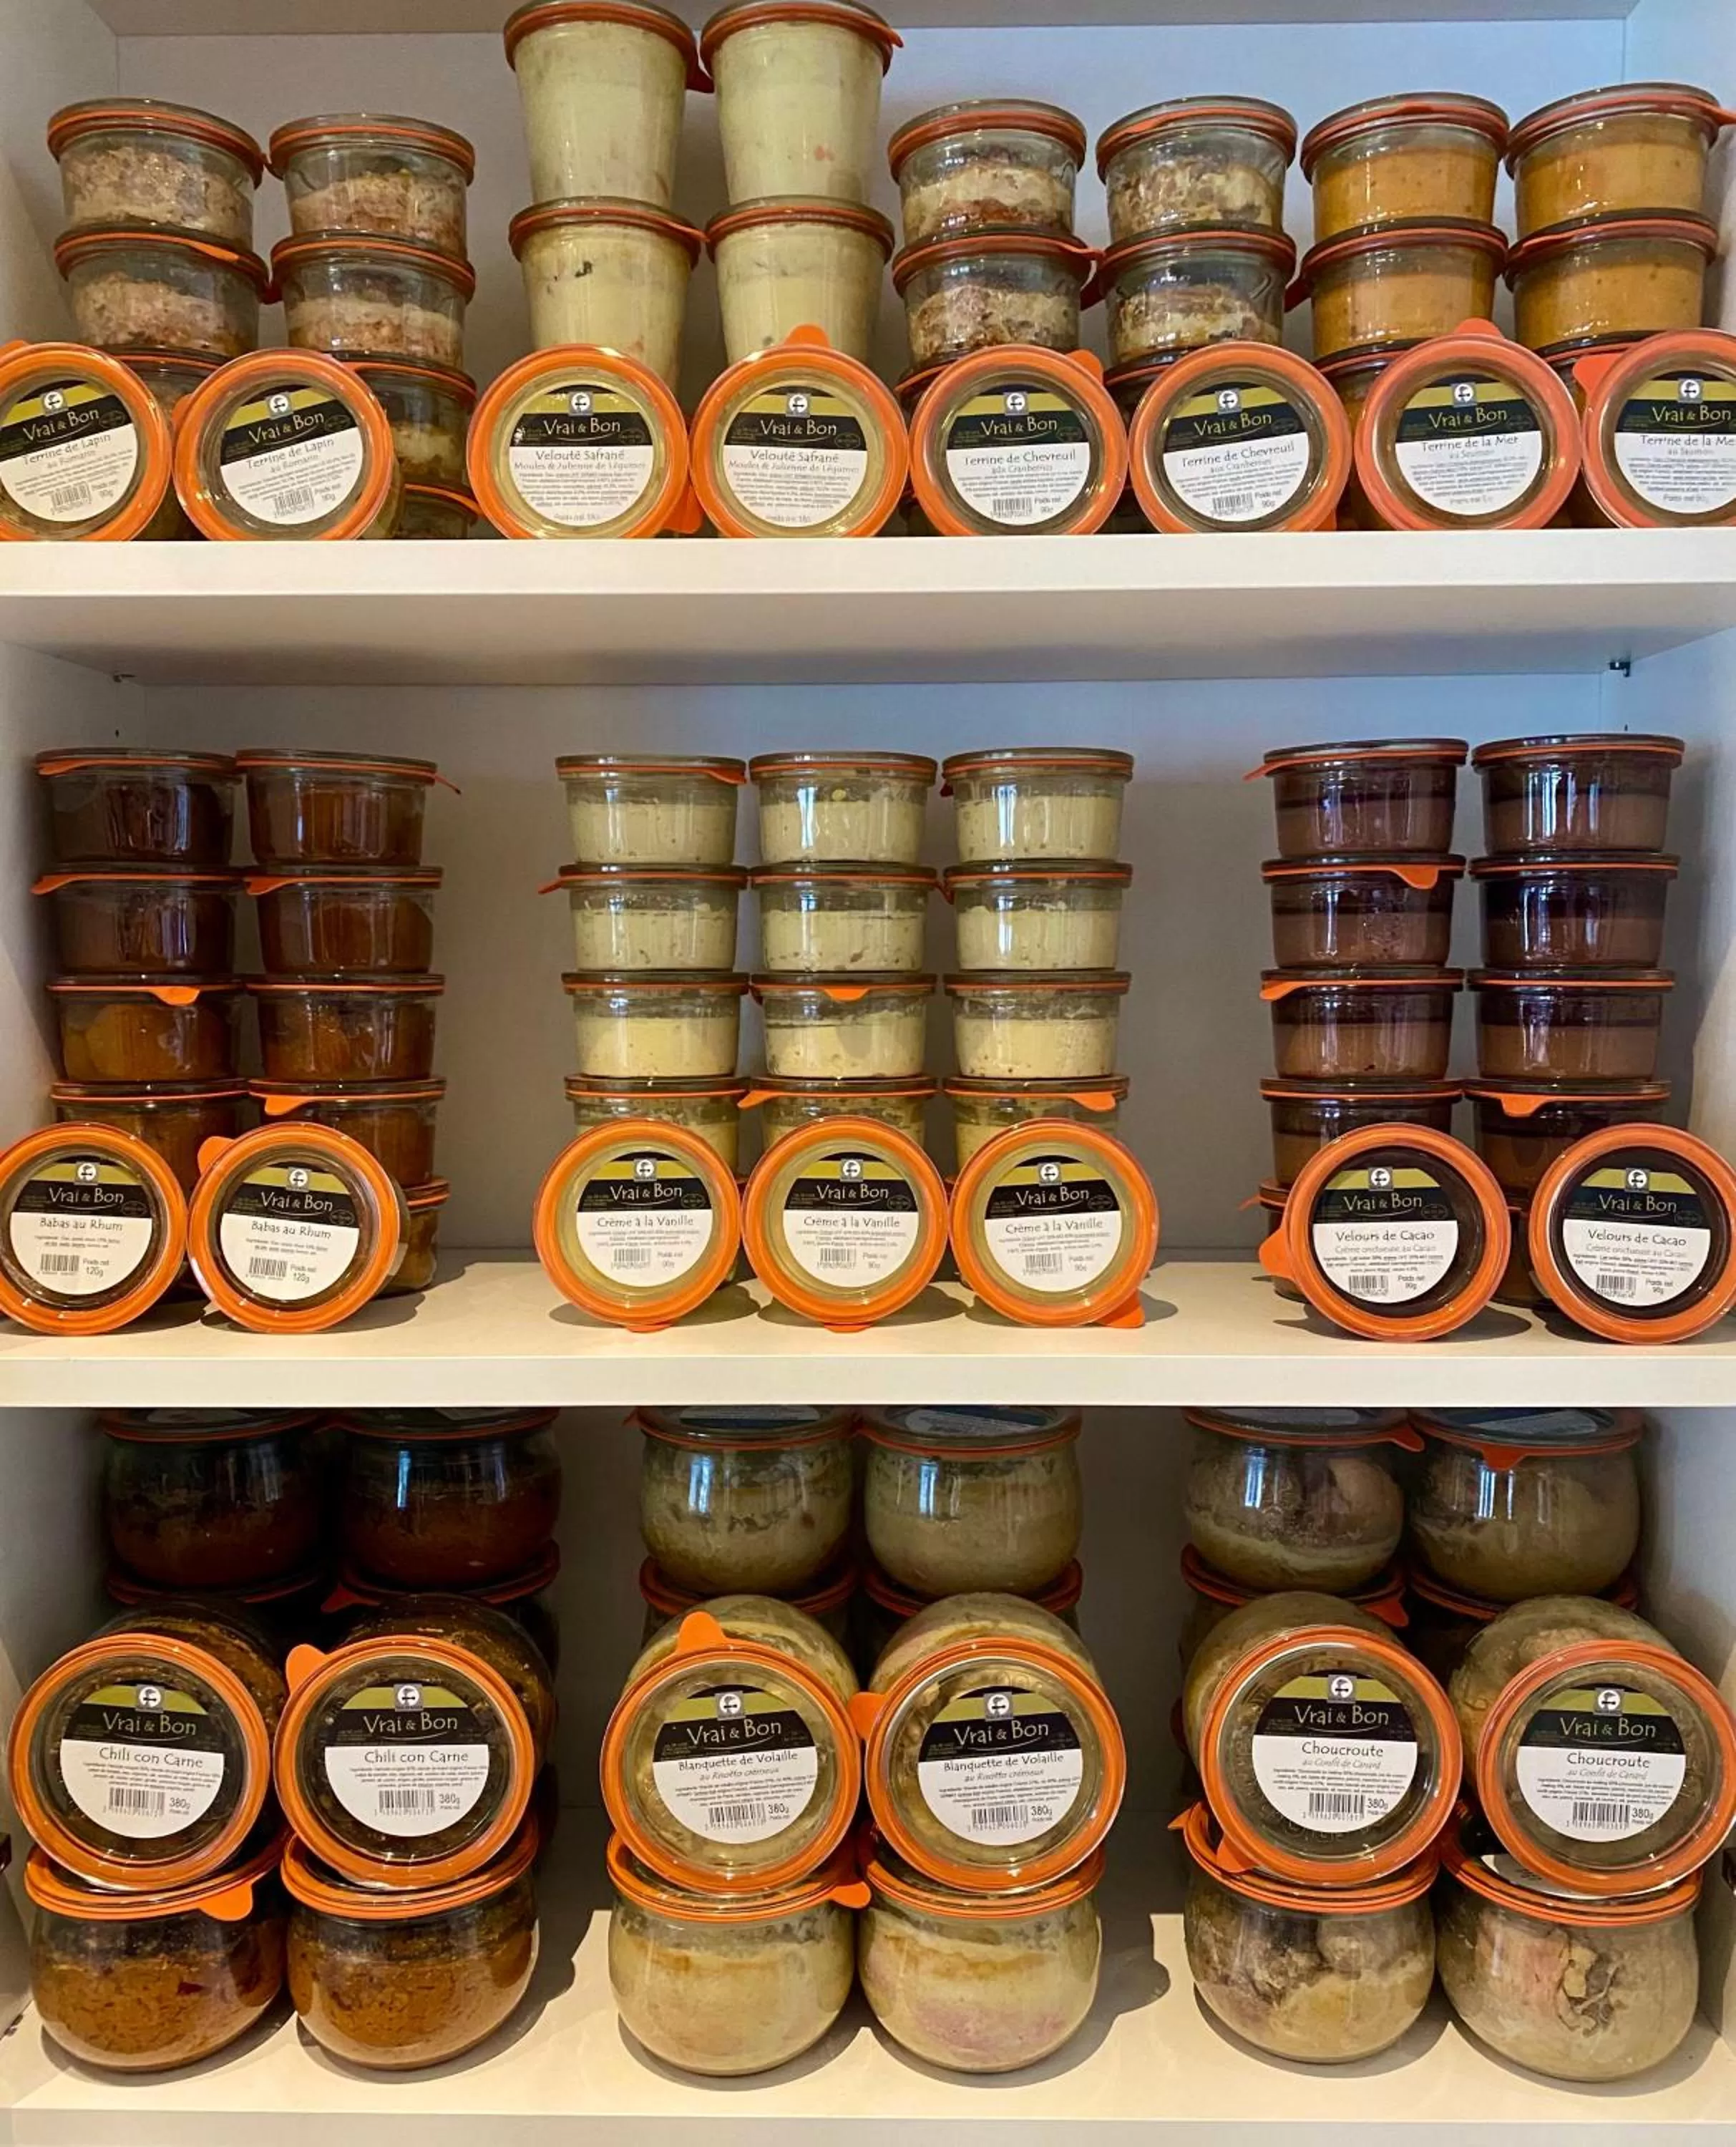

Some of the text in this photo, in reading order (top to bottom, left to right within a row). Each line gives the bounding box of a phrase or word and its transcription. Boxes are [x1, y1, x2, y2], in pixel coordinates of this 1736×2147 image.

[1429, 412, 1461, 429] Vrai
[1476, 407, 1507, 423] Bon
[1652, 406, 1683, 422] Vrai
[1700, 405, 1731, 421] Bon
[23, 409, 99, 441] Vrai & Bon
[249, 412, 324, 444] Vrai & Bon
[543, 417, 620, 434] Vrai & Bon
[761, 419, 837, 436] Vrai & Bon
[981, 419, 1012, 436] Vrai
[1027, 417, 1057, 431] Bon
[1194, 419, 1226, 436] Vrai
[1240, 412, 1272, 428] Bon
[1422, 436, 1518, 452] Terrine de la Mer
[1640, 434, 1736, 445] Terrine de la Me
[23, 434, 111, 464] Terrine de Lapin
[246, 438, 334, 469] Terrine de Lapin
[536, 449, 624, 460] Velouté Safrané
[751, 450, 839, 462] Velouté Safrané
[965, 449, 1076, 465] Terrine de Chevreuil
[1182, 441, 1294, 467] Terrine de Chevreuil
[49, 1187, 79, 1203] Vrai
[94, 1187, 124, 1204] Bon
[610, 1185, 639, 1200] Vrai
[654, 1183, 682, 1197] Bon
[816, 1184, 845, 1199] Vrai
[861, 1184, 889, 1199] Bon
[1015, 1191, 1046, 1206] Vrai
[1060, 1186, 1090, 1202] Bon
[261, 1192, 333, 1212] Vrai & Bon
[1343, 1195, 1375, 1212] Vrai
[1391, 1192, 1423, 1208] Bon
[1599, 1194, 1677, 1212] Vrai & Bon
[39, 1217, 69, 1228] Babas
[90, 1219, 123, 1231] Rhum
[251, 1221, 331, 1238] Babas au Rhum
[597, 1215, 693, 1228] Crème à la Vanille
[804, 1217, 900, 1227] Crème à la Vanille
[1005, 1217, 1103, 1234] Crème à la Vanille
[1335, 1230, 1435, 1242] Velours de Cacao
[1588, 1229, 1687, 1247] Velours de Cacao
[364, 1712, 458, 1733] Vrai & Bon
[1294, 1705, 1389, 1725] Vrai & Bon
[103, 1712, 196, 1736] Vrai & Bon
[686, 1718, 781, 1745] Vrai & Bon
[1559, 1717, 1656, 1738] Vrai & Bon
[954, 1720, 1049, 1746] Vrai & Bon
[99, 1747, 203, 1768] Chili con Carne
[364, 1750, 469, 1763] Chili con Carne
[1302, 1741, 1384, 1758] Choucroute
[678, 1750, 798, 1773] Blanquette de Volaille
[944, 1752, 1063, 1773] Blanquette de Volaille
[1566, 1752, 1651, 1768] Choucroute
[169, 1797, 191, 1809] 380g
[439, 1793, 460, 1805] 380g
[1367, 1798, 1388, 1810] 380g
[768, 1803, 789, 1814] 380g
[1031, 1806, 1053, 1816] 380g
[1632, 1807, 1654, 1820] 380g
